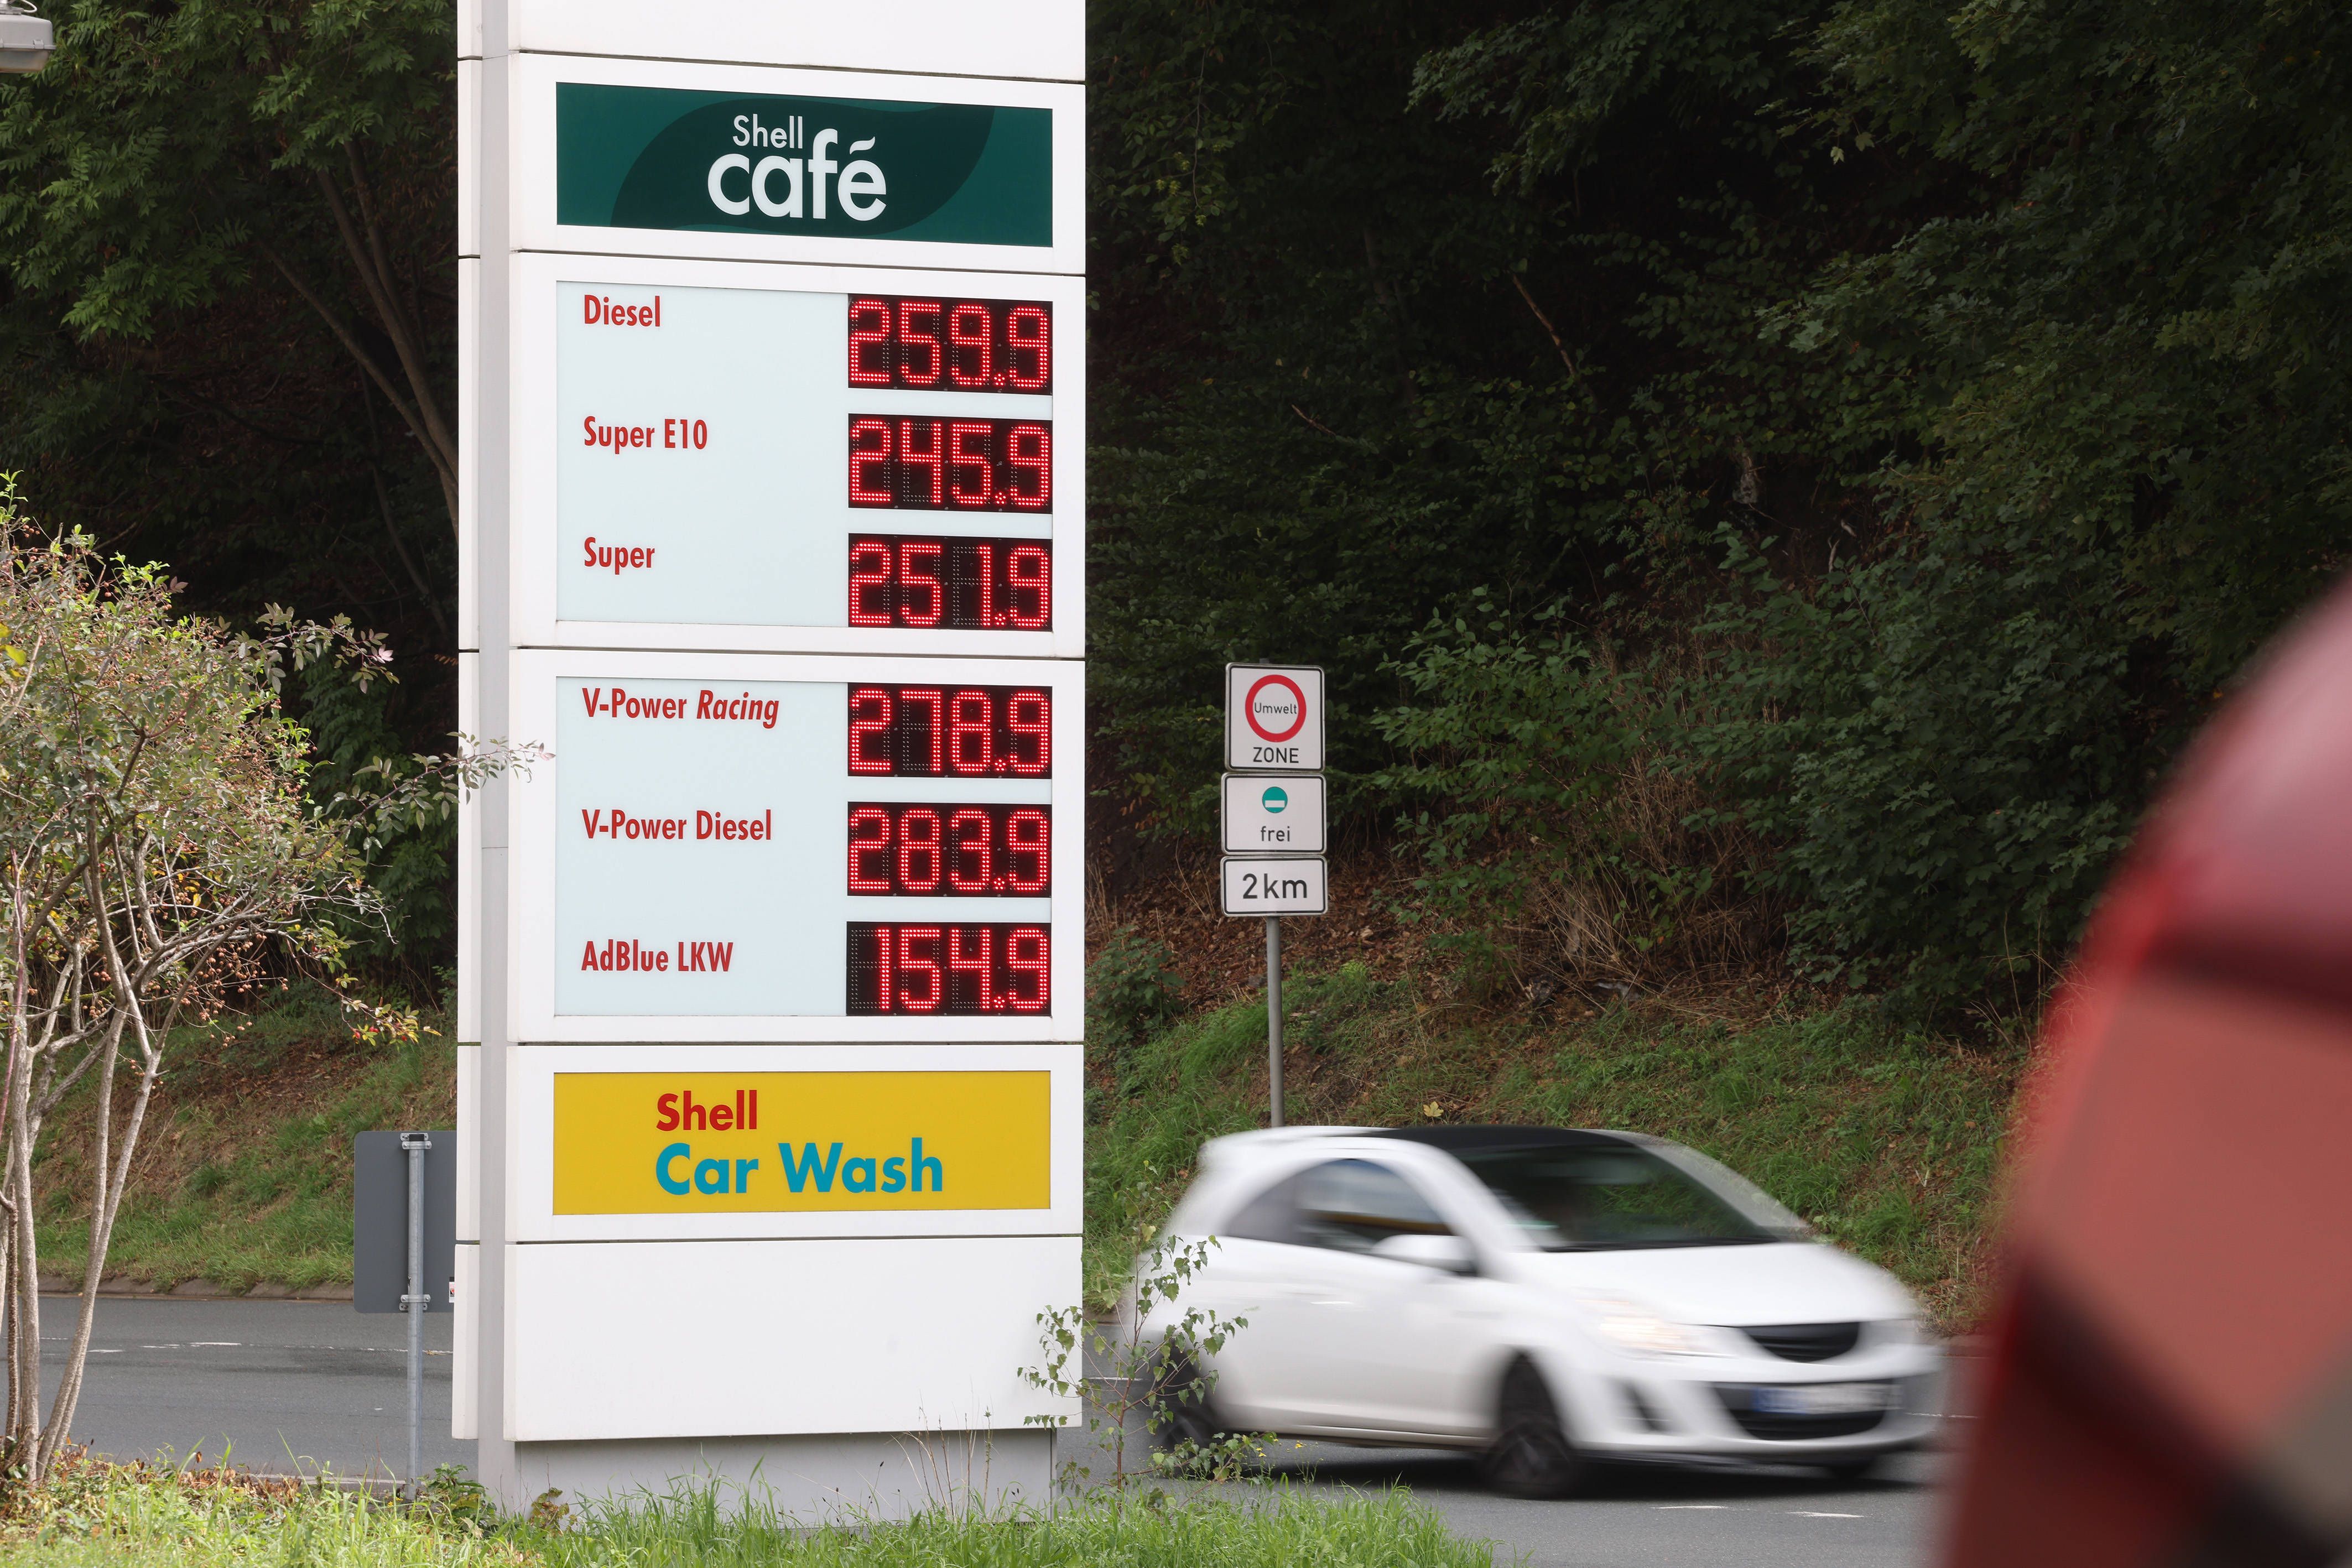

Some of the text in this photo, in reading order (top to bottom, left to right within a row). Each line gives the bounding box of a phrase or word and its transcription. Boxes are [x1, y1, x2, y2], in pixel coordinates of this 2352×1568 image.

[732, 114, 803, 149] Shell
[707, 128, 887, 222] café
[584, 294, 661, 327] Diesel
[851, 300, 1049, 388] 259.9
[584, 415, 708, 455] Super E10
[851, 419, 1049, 507] 245.9
[584, 536, 655, 576] Super
[851, 542, 1049, 627] 251.9
[582, 687, 780, 730] V-Power Racing
[1254, 701, 1298, 715] Umwelt
[851, 689, 1049, 773] 278.9
[1252, 746, 1299, 764] ZONE
[581, 809, 772, 841] V-Power Diesel
[1260, 825, 1291, 842] frei
[850, 808, 1049, 892] 283.9
[581, 938, 734, 972] AdBlue LKW
[877, 928, 1049, 1011] 154.9
[655, 1089, 758, 1132] Shell
[655, 1137, 943, 1196] Car Wash
